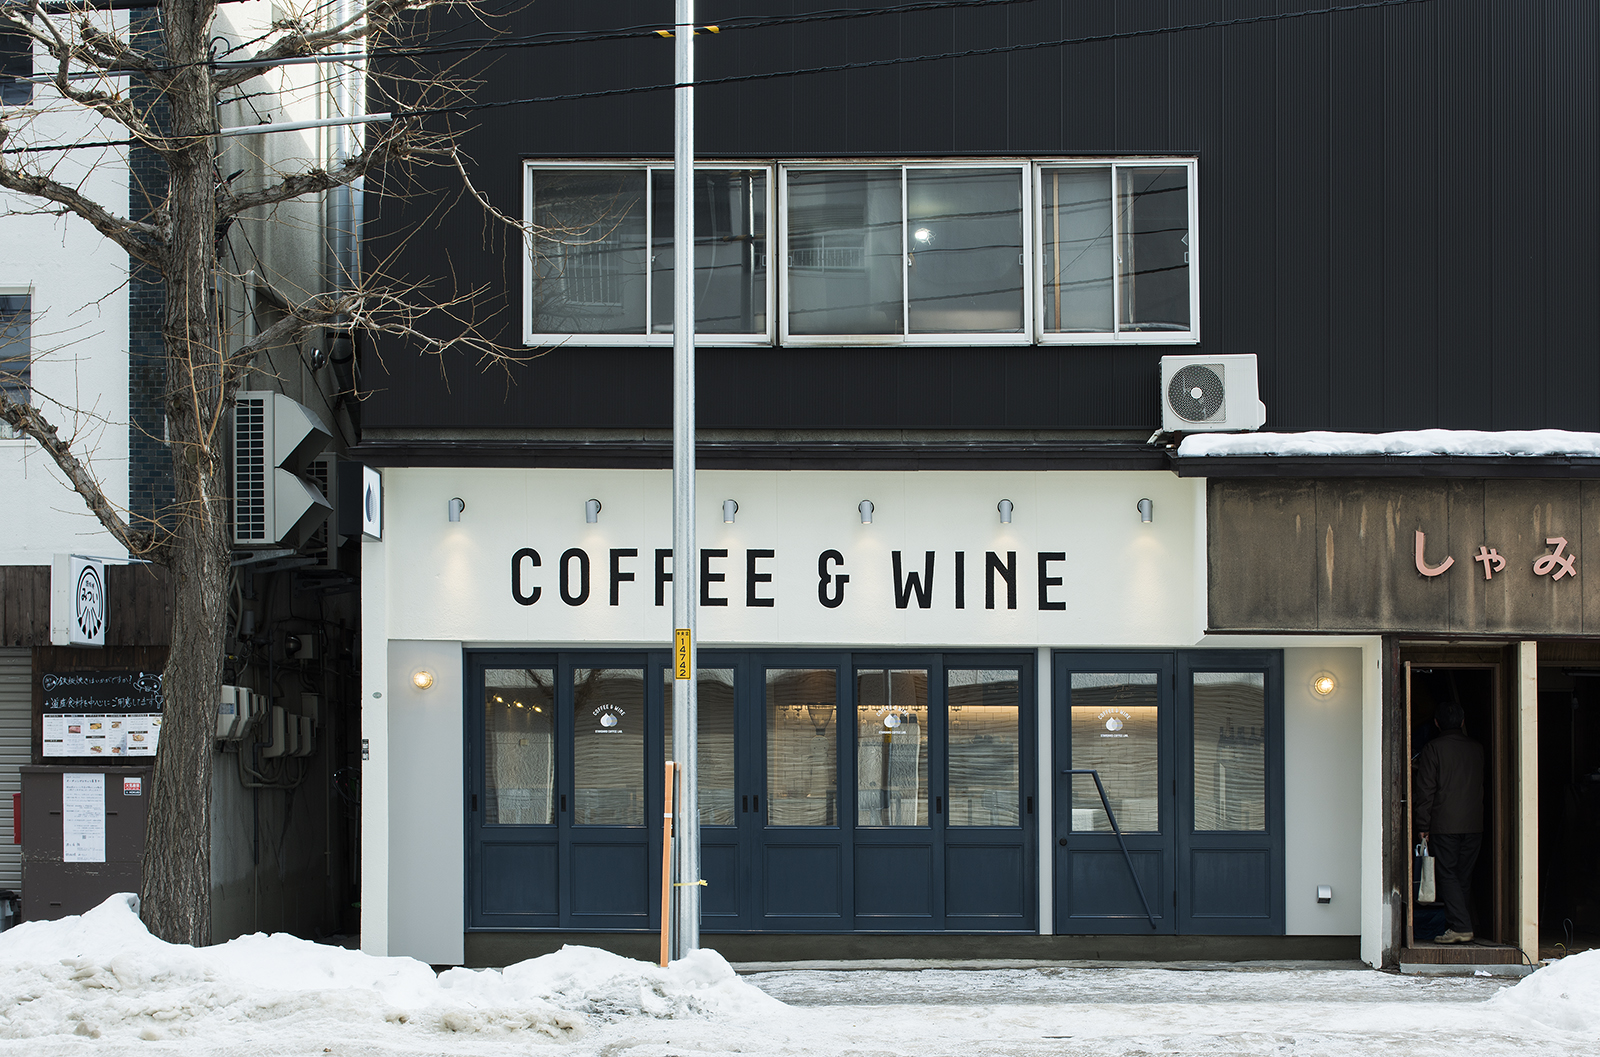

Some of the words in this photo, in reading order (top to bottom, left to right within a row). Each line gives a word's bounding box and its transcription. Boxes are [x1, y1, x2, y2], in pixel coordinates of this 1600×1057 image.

[510, 547, 775, 608] COFFEE
[817, 549, 850, 608] &
[890, 550, 1067, 611] WINE
[1415, 530, 1577, 581] しゃみ
